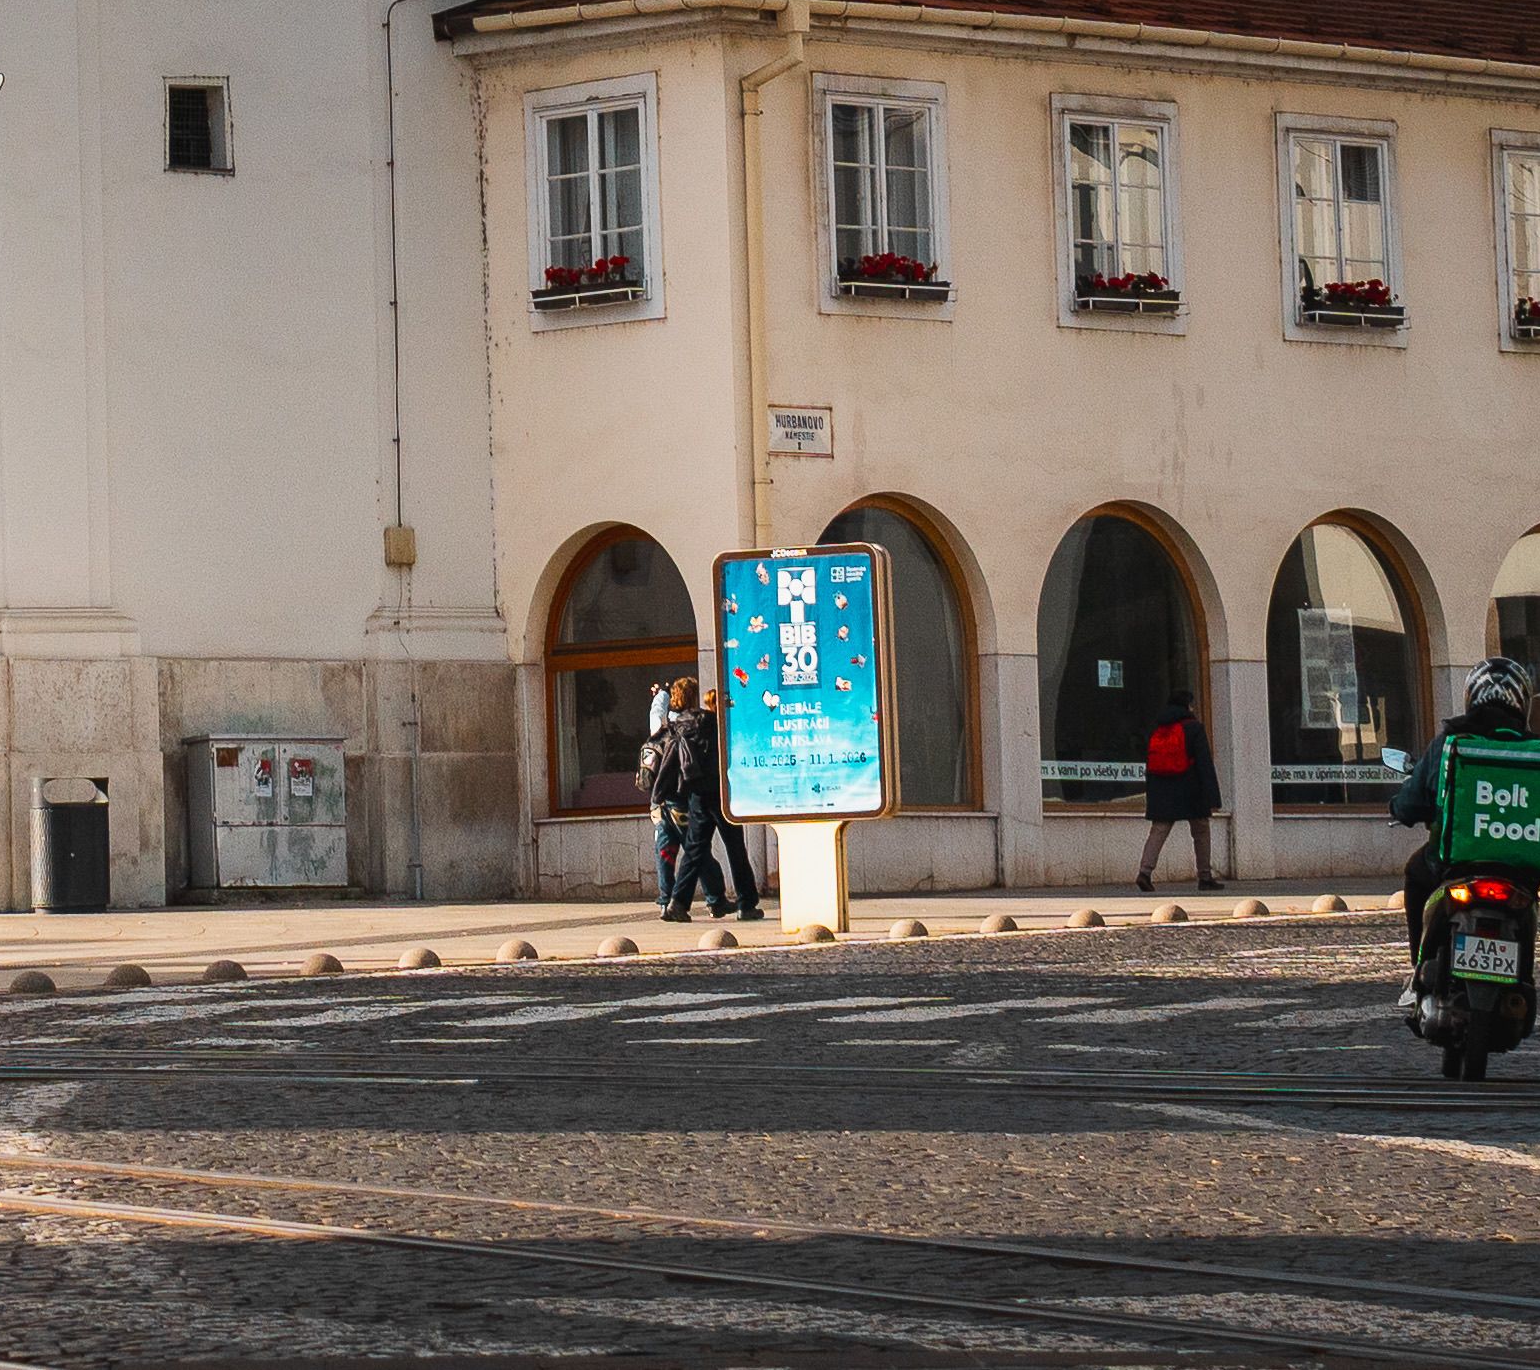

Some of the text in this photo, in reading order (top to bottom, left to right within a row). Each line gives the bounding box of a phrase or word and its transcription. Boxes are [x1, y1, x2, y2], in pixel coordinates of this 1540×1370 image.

[775, 414, 824, 430] HURBANOVO
[779, 623, 817, 646] BIB
[781, 646, 818, 672] 30
[772, 754, 796, 766] 2025
[842, 752, 866, 763] 2026
[1058, 765, 1078, 776] vami
[1080, 767, 1091, 778] po
[1476, 780, 1529, 814] Bolt
[1474, 813, 1540, 842] Food
[1475, 940, 1497, 955] AA
[1456, 953, 1515, 973] 463PX
